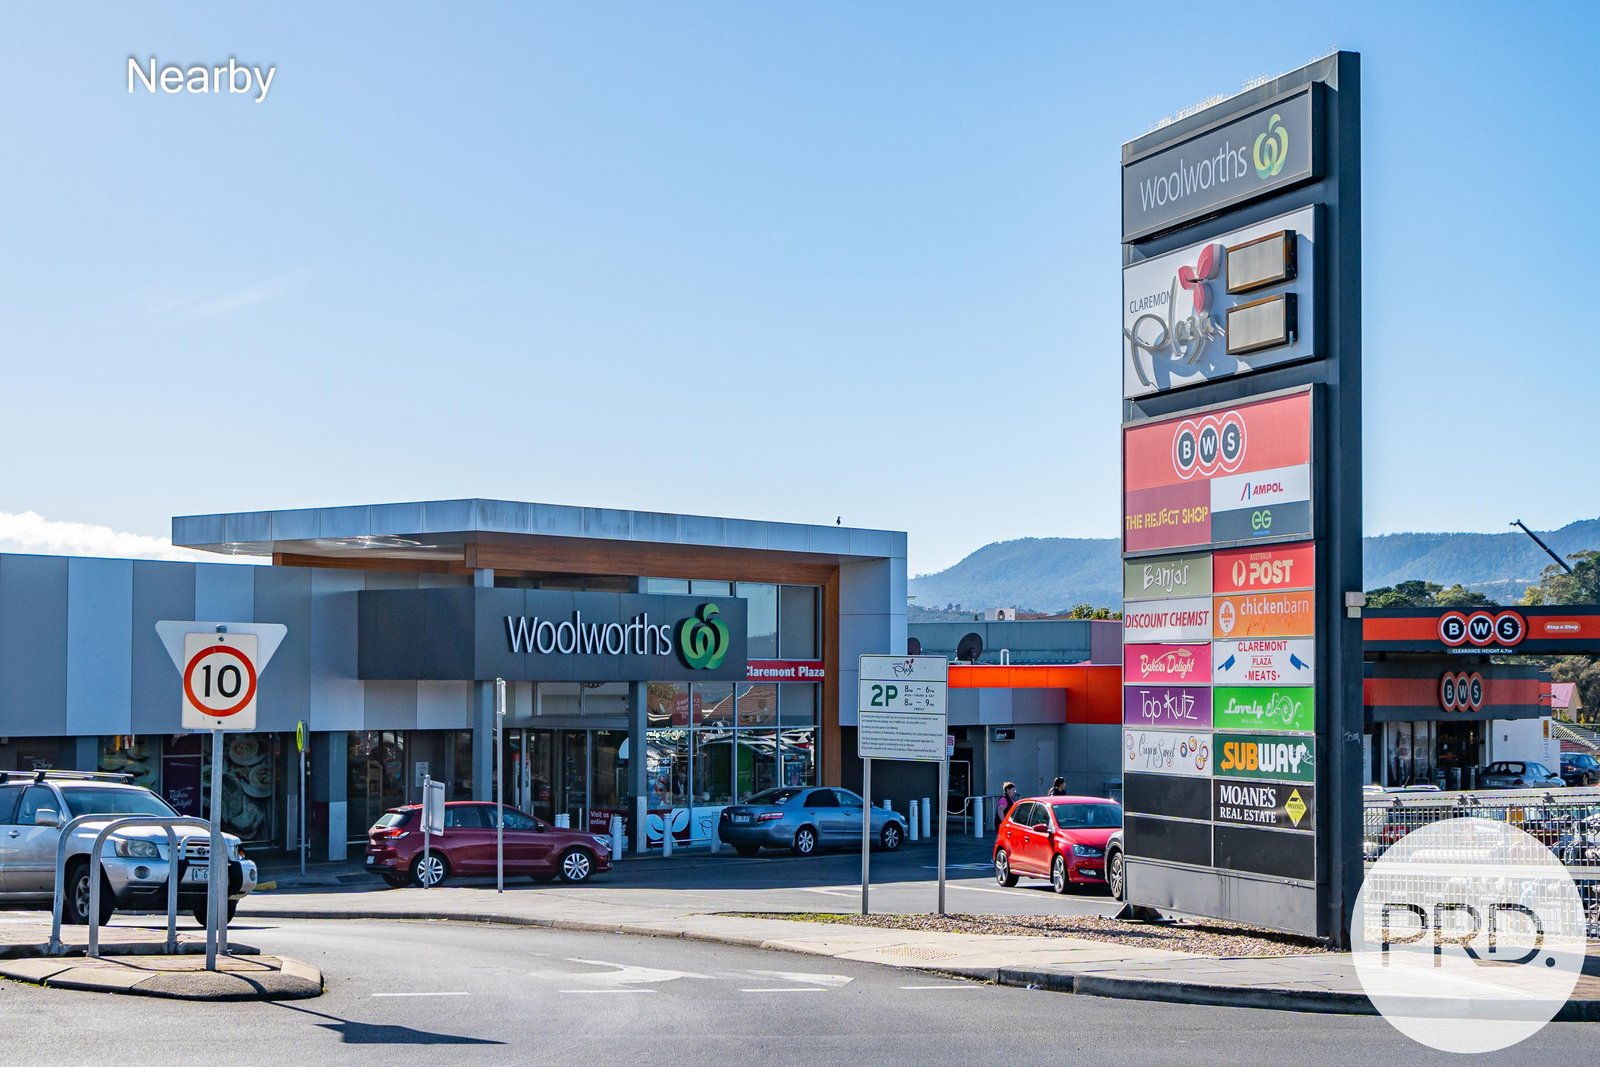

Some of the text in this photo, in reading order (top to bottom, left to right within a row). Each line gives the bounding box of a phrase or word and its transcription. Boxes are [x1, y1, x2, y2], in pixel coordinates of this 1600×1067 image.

[1140, 141, 1248, 212] Woolworths
[1129, 290, 1172, 314] CLAREMON
[1253, 482, 1283, 496] AMPOL
[1126, 506, 1208, 530] THE REJECT SHOP
[1143, 558, 1190, 593] Banjo's
[1250, 559, 1293, 585] POST
[1240, 596, 1309, 616] chickenbarn
[1125, 612, 1168, 629] DISCOUNT
[1169, 610, 1210, 627] CHEMIST
[508, 610, 672, 656] Woolworths
[1238, 640, 1288, 652] CLAREMONT
[798, 666, 825, 677] Plaza
[1140, 654, 1195, 679] Bakers Delight
[1252, 657, 1272, 666] PLAZA
[202, 664, 241, 698] 10
[871, 684, 898, 707] 2P
[1140, 690, 1162, 725] Top
[1224, 698, 1264, 719] Lovely
[1220, 741, 1307, 774] SUBWAY
[1220, 785, 1276, 808] MOANE'S
[590, 810, 602, 818] Visit
[590, 818, 607, 826] online
[1220, 806, 1276, 824] REAL ESTATE
